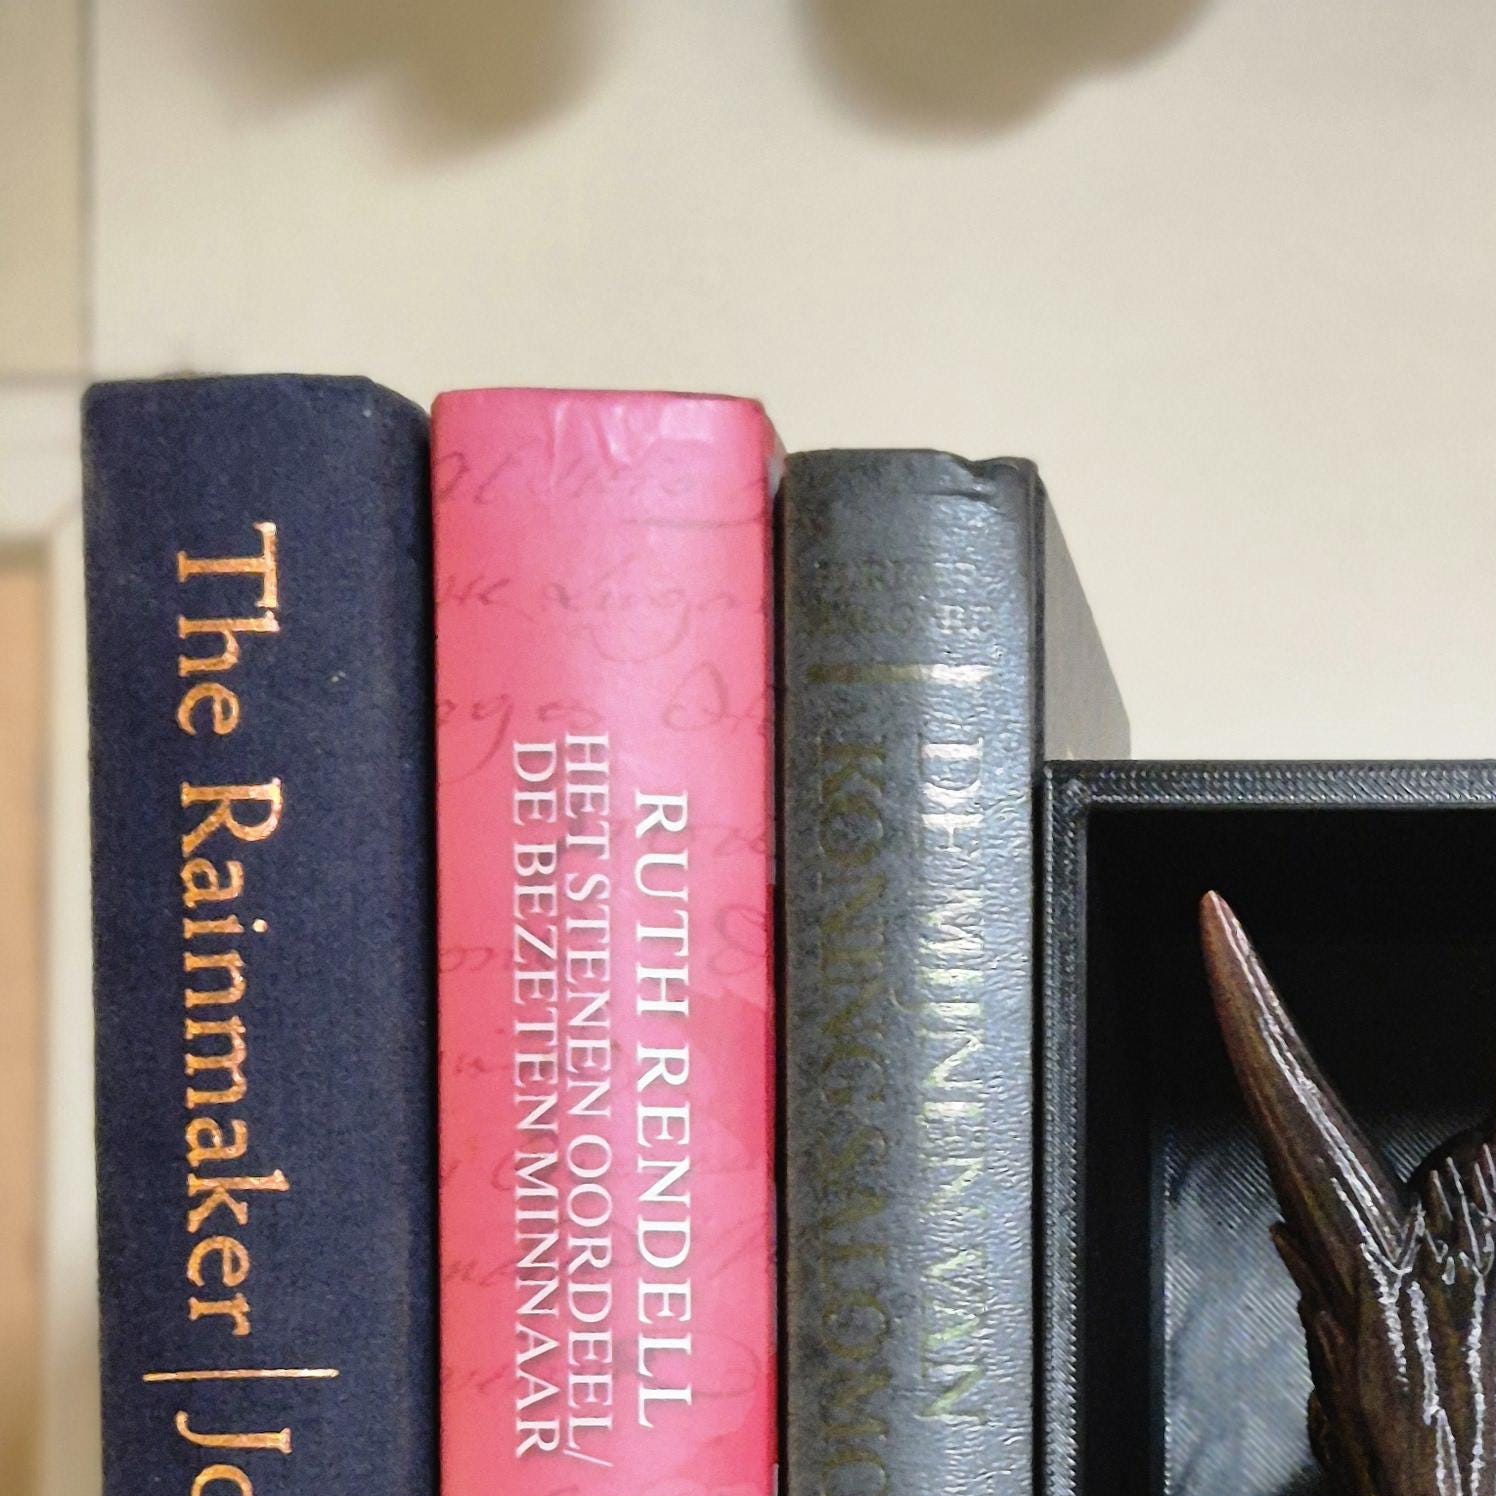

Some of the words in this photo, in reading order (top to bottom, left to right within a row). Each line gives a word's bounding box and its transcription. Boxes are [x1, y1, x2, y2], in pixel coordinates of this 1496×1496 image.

[176, 521, 280, 736] The
[513, 741, 558, 826] DE
[565, 731, 610, 860] HET
[916, 737, 986, 856] DE
[513, 842, 559, 1131] BEZETEN
[565, 872, 612, 1117] STENEN
[635, 787, 689, 1018] RUTH
[179, 776, 290, 1337] Rainmaker
[515, 1150, 560, 1459] MINNAAR
[635, 1041, 693, 1429] RENDELL
[914, 1243, 988, 1428] VAN
